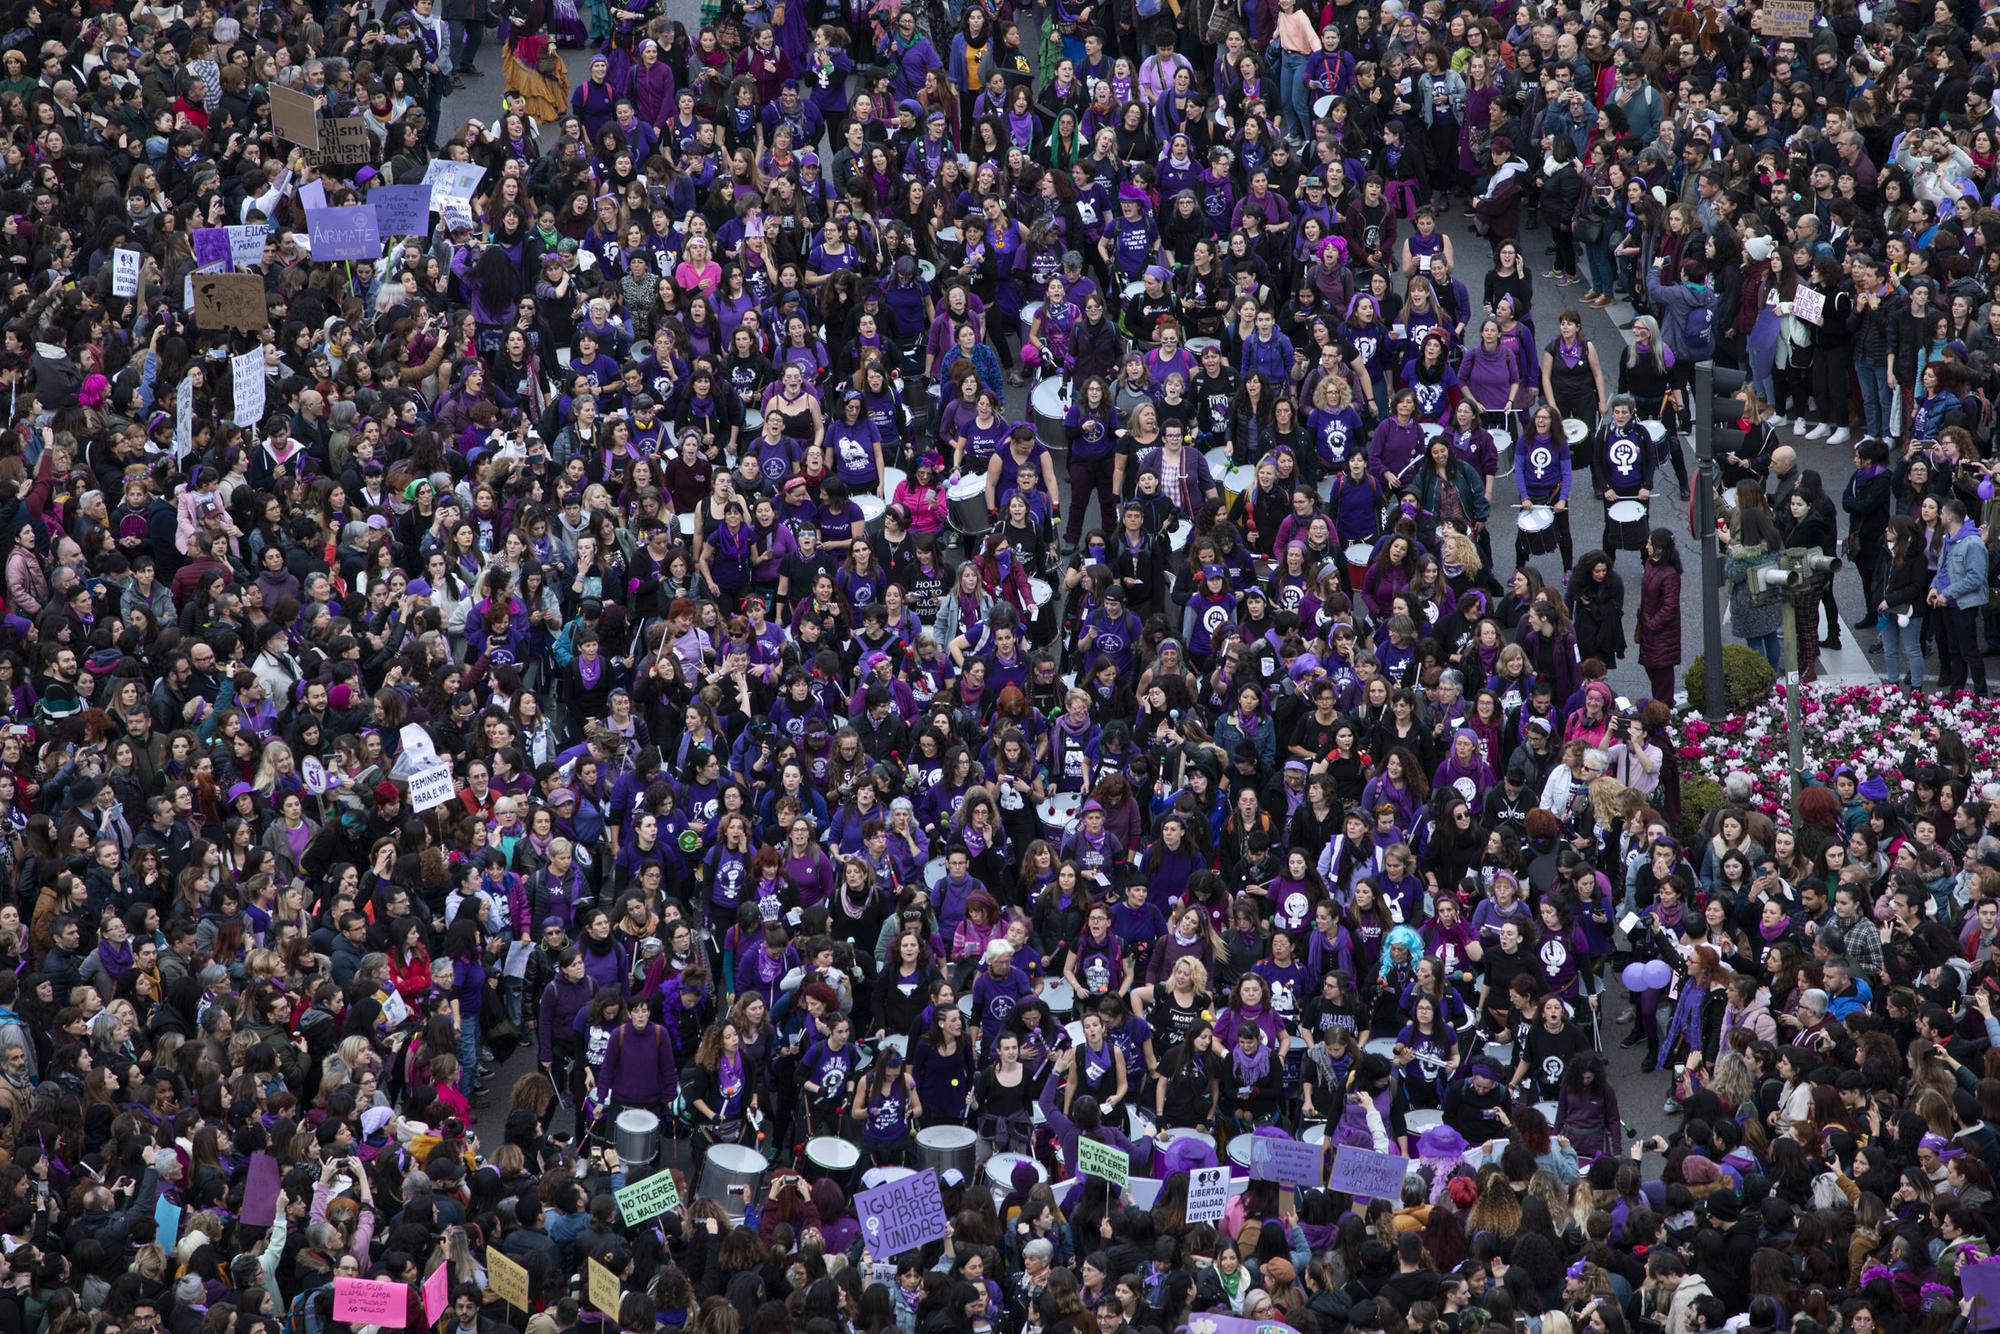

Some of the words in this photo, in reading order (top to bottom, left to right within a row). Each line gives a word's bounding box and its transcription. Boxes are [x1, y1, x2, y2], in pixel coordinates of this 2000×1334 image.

[1764, 1, 1785, 9] ESTA
[1803, 3, 1814, 12] ES
[323, 119, 337, 129] NI
[326, 137, 340, 147] NI
[244, 225, 270, 238] ELLAS
[238, 241, 261, 251] MUNDO
[1795, 286, 1807, 298] NO
[1806, 290, 1821, 304] NOS
[1795, 297, 1814, 311] MIRES
[235, 357, 245, 368] NI
[915, 580, 941, 589] HOLD
[916, 597, 934, 607] EAC
[411, 768, 449, 791] FEMINISMO
[414, 789, 432, 804] PARA
[1080, 1148, 1092, 1160] NO
[1093, 1153, 1128, 1175] TOLERES
[1080, 1160, 1089, 1171] EL
[1090, 1163, 1126, 1185] MALTRATO
[641, 1182, 651, 1192] por
[1190, 1187, 1227, 1198] LIBERTAD,
[621, 1198, 635, 1211] NO
[635, 1181, 675, 1205] TOLERES
[863, 1172, 937, 1216] IGUALES
[625, 1212, 638, 1224] EL
[637, 1194, 677, 1218] MALTRATO
[1189, 1198, 1225, 1210] IGUALDAD,
[881, 1190, 943, 1232] LIBRES
[1188, 1210, 1224, 1221] AMISTAD.
[885, 1214, 944, 1250] UNIDAS
[350, 1282, 363, 1290] LO
[365, 1283, 384, 1292] QUE
